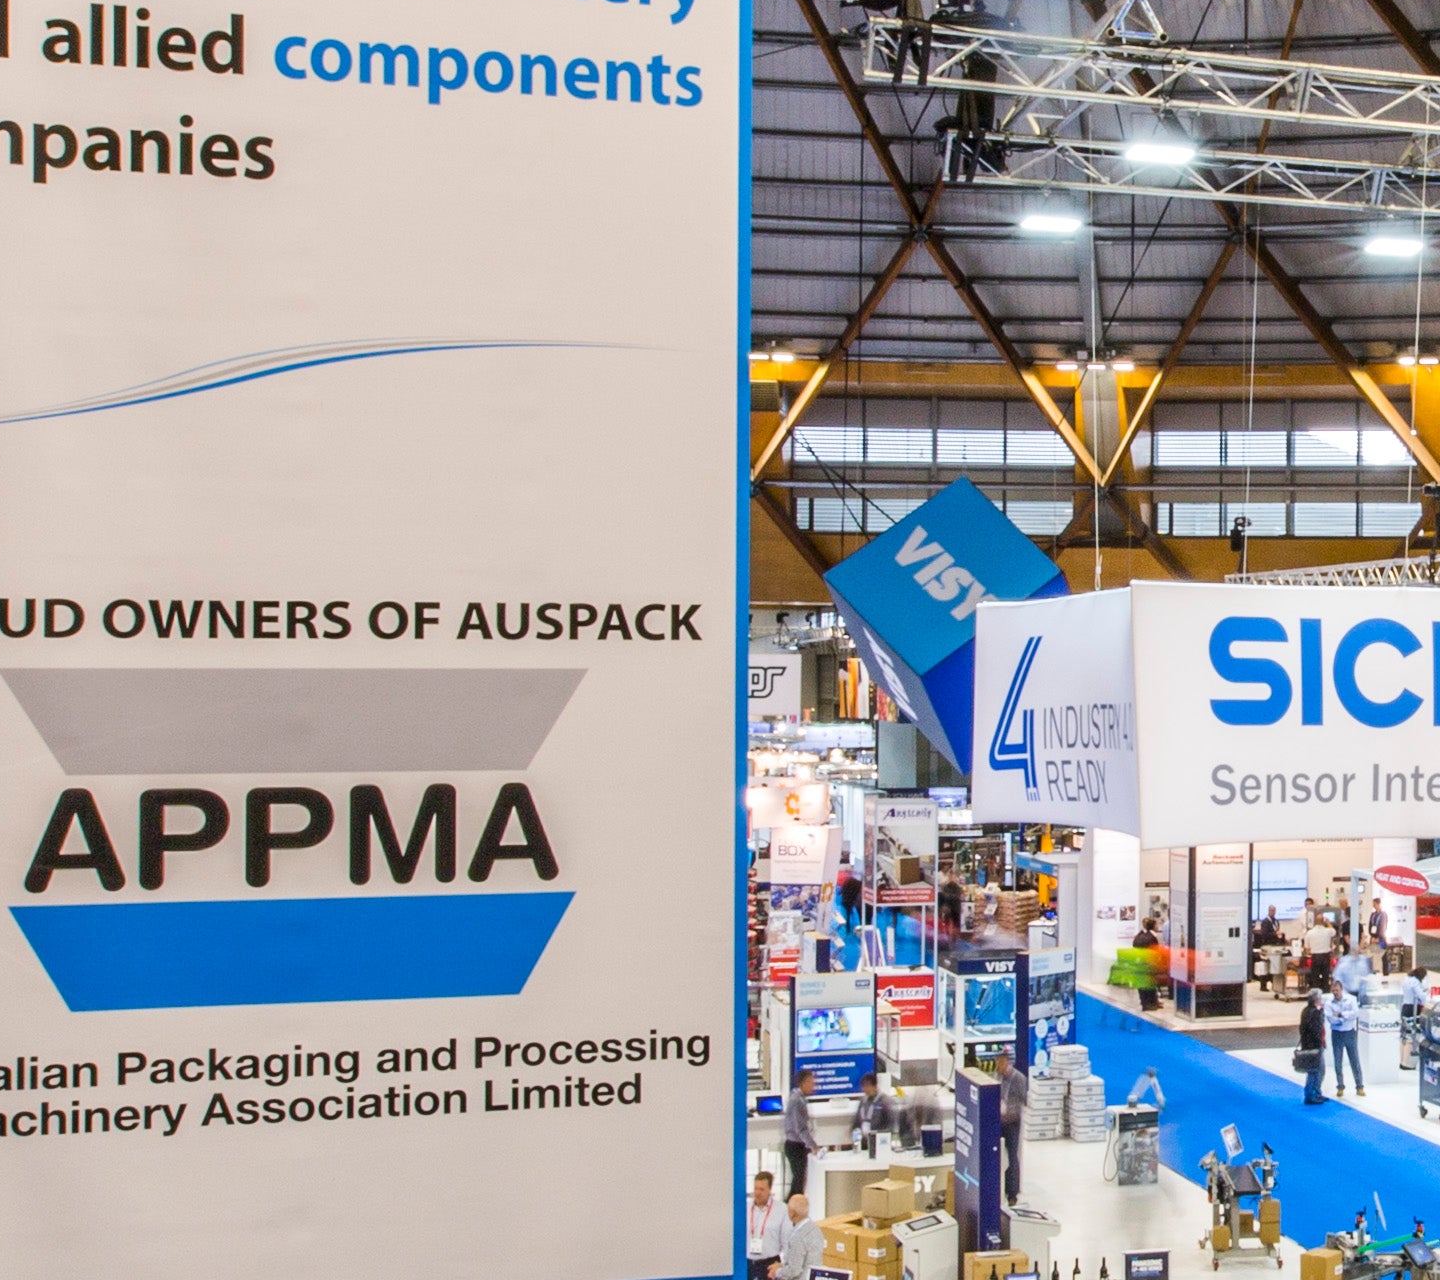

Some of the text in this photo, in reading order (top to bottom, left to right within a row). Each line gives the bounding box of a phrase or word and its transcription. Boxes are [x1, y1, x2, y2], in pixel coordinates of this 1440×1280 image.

[41, 3, 246, 76] allied
[273, 34, 704, 108] components
[894, 525, 1000, 621] VISY
[103, 598, 352, 641] OWNERS
[368, 601, 440, 641] OF
[457, 603, 702, 642] AUSPACK
[1043, 703, 1121, 750] INDUSTRY
[1046, 759, 1108, 804] READY
[1210, 763, 1355, 806] Sensor
[24, 782, 560, 893] APPMA
[986, 960, 1016, 972] VISY
[116, 1043, 363, 1092] Packaging
[376, 1037, 459, 1075] and
[473, 1028, 712, 1077] Processing
[202, 1084, 468, 1129] Association
[482, 1072, 643, 1114] Limited
